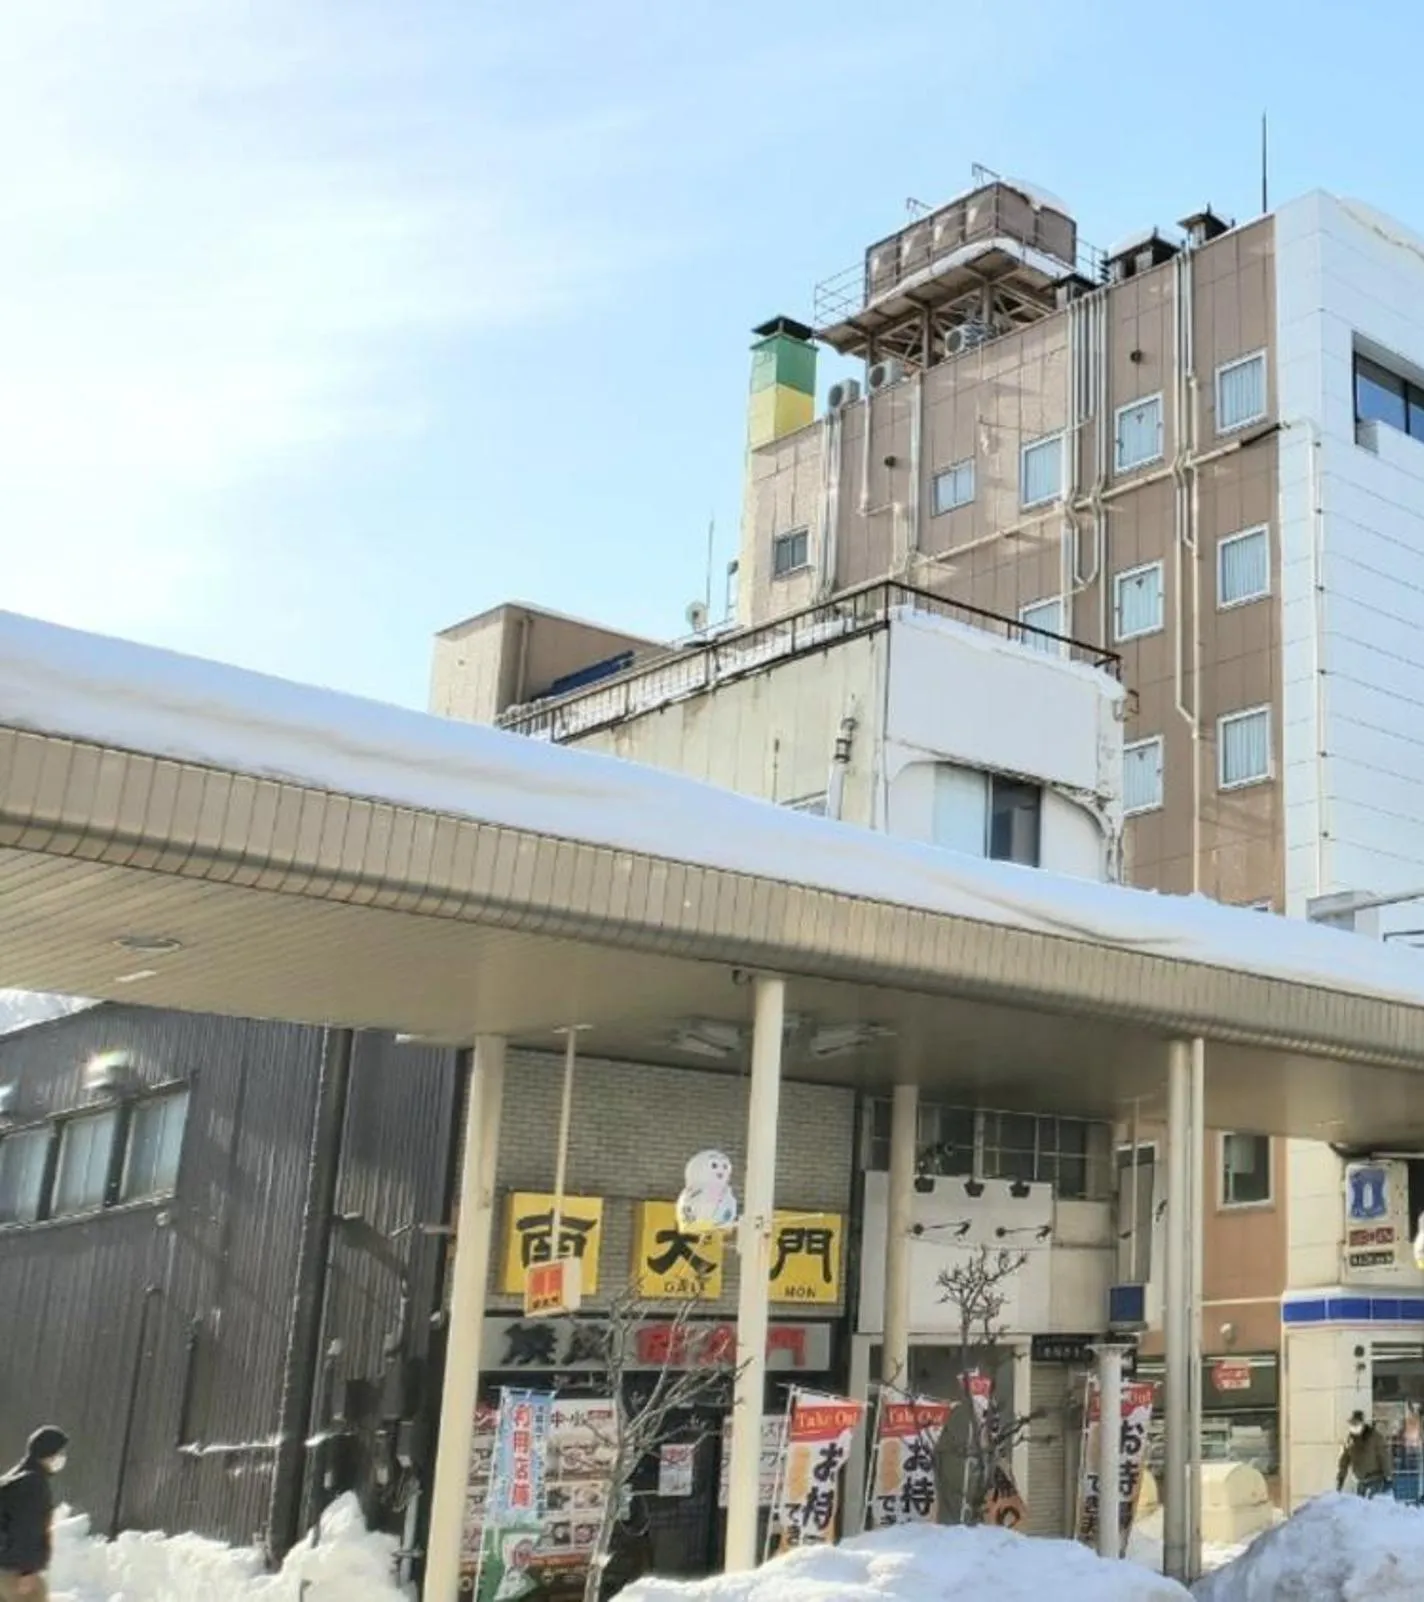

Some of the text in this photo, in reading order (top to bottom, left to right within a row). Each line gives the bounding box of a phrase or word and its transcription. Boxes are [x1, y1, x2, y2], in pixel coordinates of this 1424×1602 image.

[769, 1227, 832, 1284] 門
[799, 1411, 831, 1427] Take
[803, 1442, 843, 1542] お持
